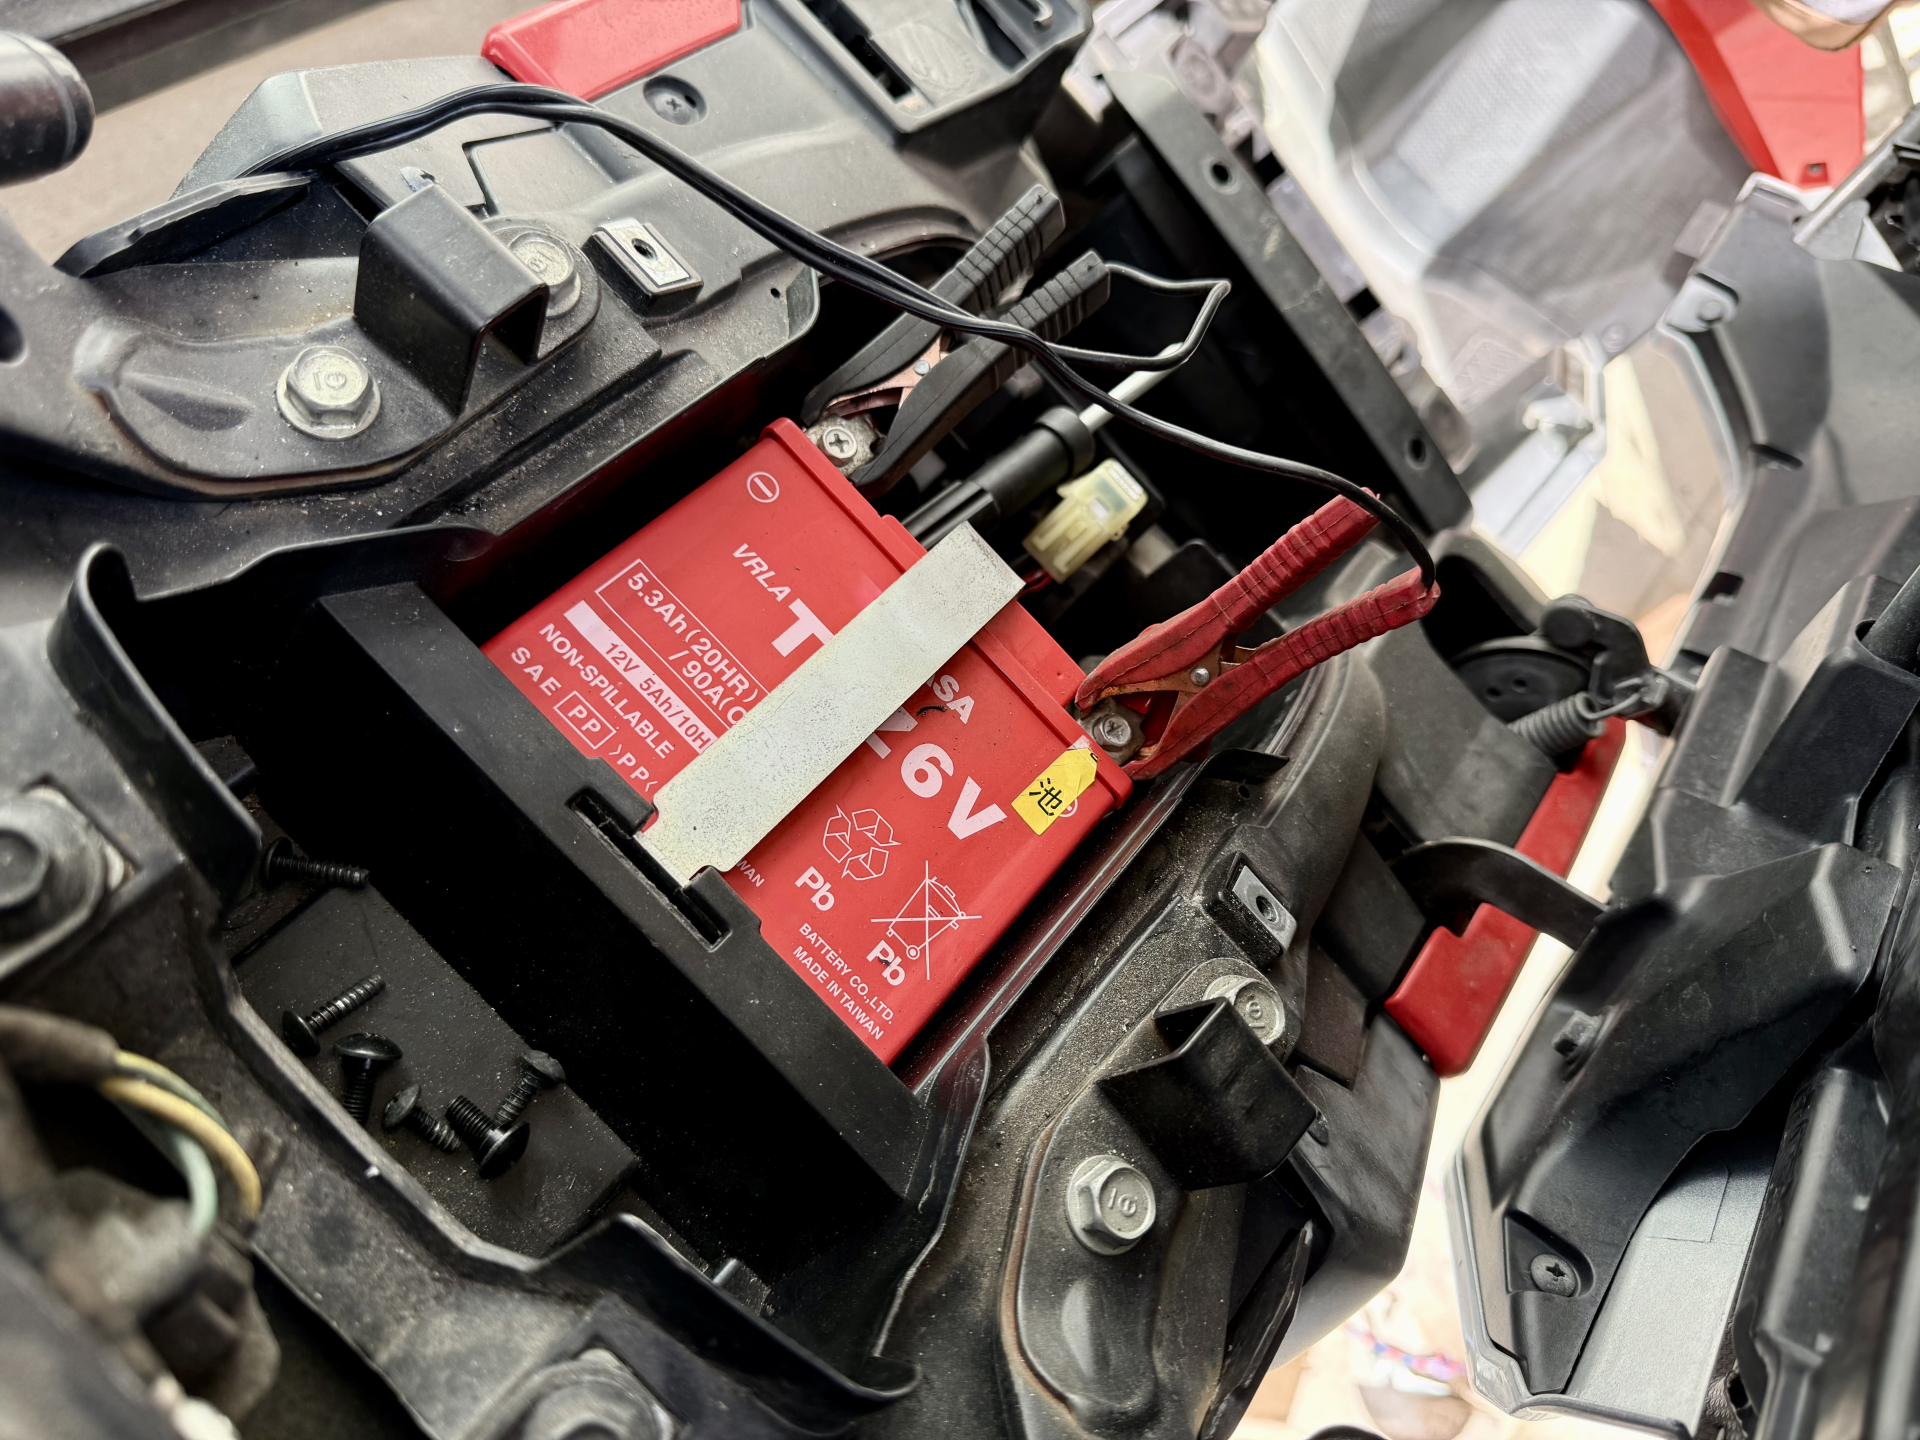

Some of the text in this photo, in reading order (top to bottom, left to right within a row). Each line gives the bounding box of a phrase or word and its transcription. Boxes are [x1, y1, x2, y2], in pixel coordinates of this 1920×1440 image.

[733, 543, 792, 602] VRLA
[604, 642, 641, 674] 12V
[628, 572, 759, 703] 5.3Ah(20HR)
[539, 623, 675, 759] NON-SPILLABLE
[926, 673, 975, 725] SA
[567, 704, 602, 733] PP
[1028, 777, 1063, 817] 池
[795, 866, 835, 911] Pb
[799, 922, 853, 977] BATTERY
[866, 940, 906, 987] Pb
[792, 945, 885, 1041] MADE IN TAIWAN
